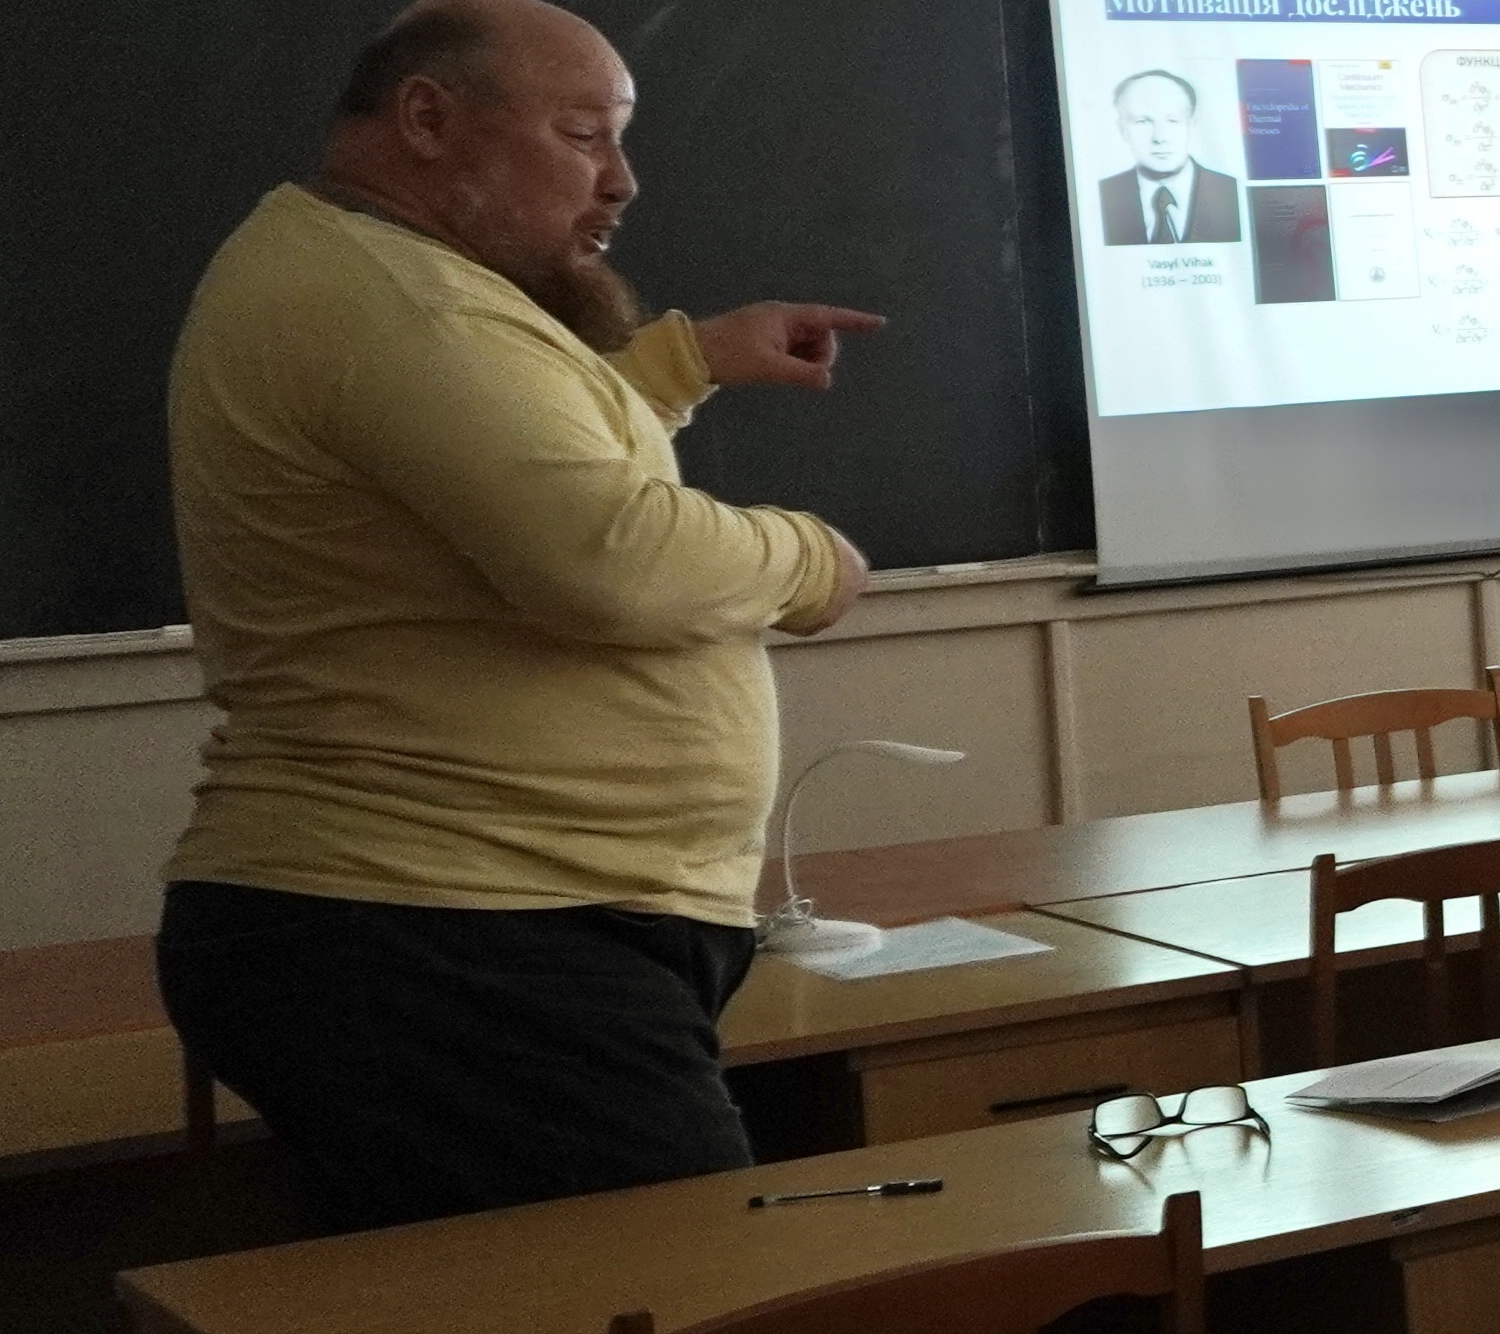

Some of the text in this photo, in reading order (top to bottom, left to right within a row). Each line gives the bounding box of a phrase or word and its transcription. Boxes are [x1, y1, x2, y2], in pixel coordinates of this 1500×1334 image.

[1147, 258, 1178, 271] Vasyl
[1142, 275, 1176, 289] (1936
[1191, 273, 1223, 287] 2003)
